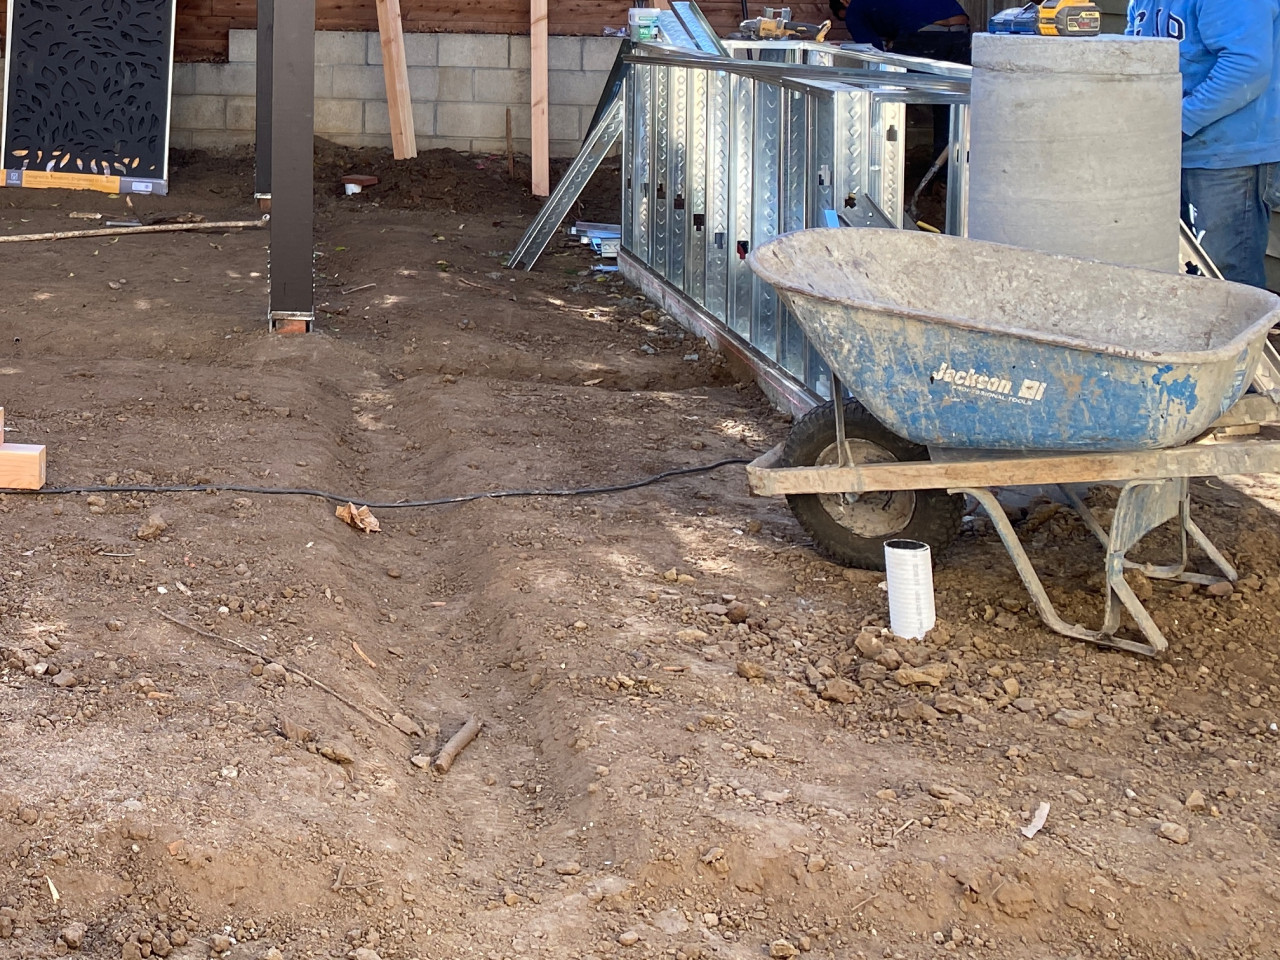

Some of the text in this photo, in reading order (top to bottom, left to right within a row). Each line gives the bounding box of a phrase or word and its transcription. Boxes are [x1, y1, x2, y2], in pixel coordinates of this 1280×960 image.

[932, 362, 1012, 394] Jackson
[952, 386, 1033, 406] PROFESSIONAL TOOLS
